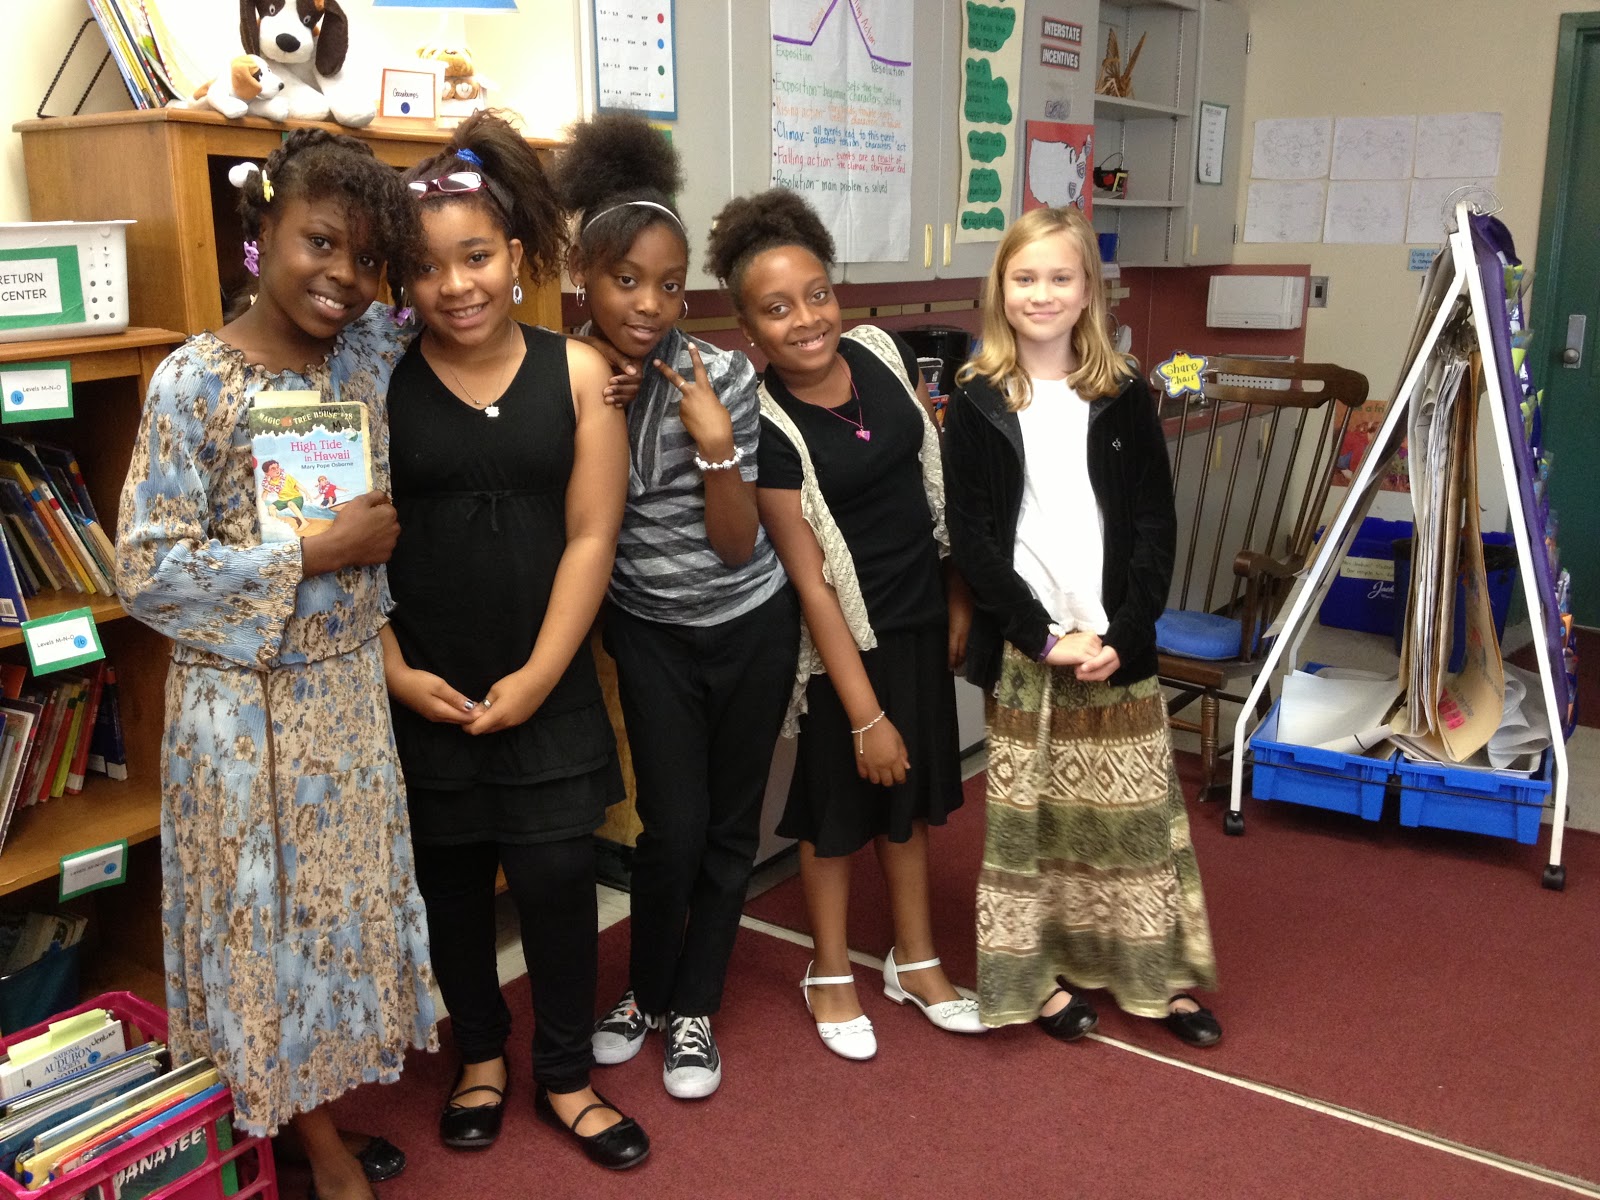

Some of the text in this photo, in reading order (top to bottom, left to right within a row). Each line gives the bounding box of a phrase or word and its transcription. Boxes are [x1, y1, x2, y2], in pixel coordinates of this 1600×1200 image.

[1044, 21, 1081, 42] INTERSTATE
[776, 44, 812, 62] Exposition
[1042, 48, 1079, 69] INCENTIVES
[871, 59, 905, 77] Resolution
[813, 125, 821, 134] all
[859, 129, 865, 139] to
[868, 130, 879, 140] this
[813, 135, 836, 148] greatest
[777, 146, 803, 172] Falling
[836, 151, 855, 162] events
[858, 154, 868, 162] are
[870, 162, 883, 175] story
[897, 163, 906, 174] end
[821, 178, 837, 191] main
[840, 179, 861, 194] problem
[865, 183, 870, 192] is
[872, 179, 888, 193] solved
[0, 272, 43, 285] RETURN
[1, 288, 47, 302] CENTER
[1166, 362, 1198, 375] Share
[1170, 374, 1196, 385] Chair
[258, 412, 281, 426] MAGIC
[293, 413, 313, 425] TREE
[313, 410, 338, 420] HOUSE
[290, 439, 342, 453] High Tide
[304, 449, 351, 462] in Hawaii
[301, 463, 316, 471] Mary
[37, 634, 75, 648] Levels M-N-O
[91, 1030, 116, 1046] Jenkins
[44, 1044, 92, 1075] AUDUBON
[53, 1045, 80, 1060] NATIONAL
[58, 1060, 80, 1072] SOCIETY
[98, 1127, 207, 1200] MANATEE
